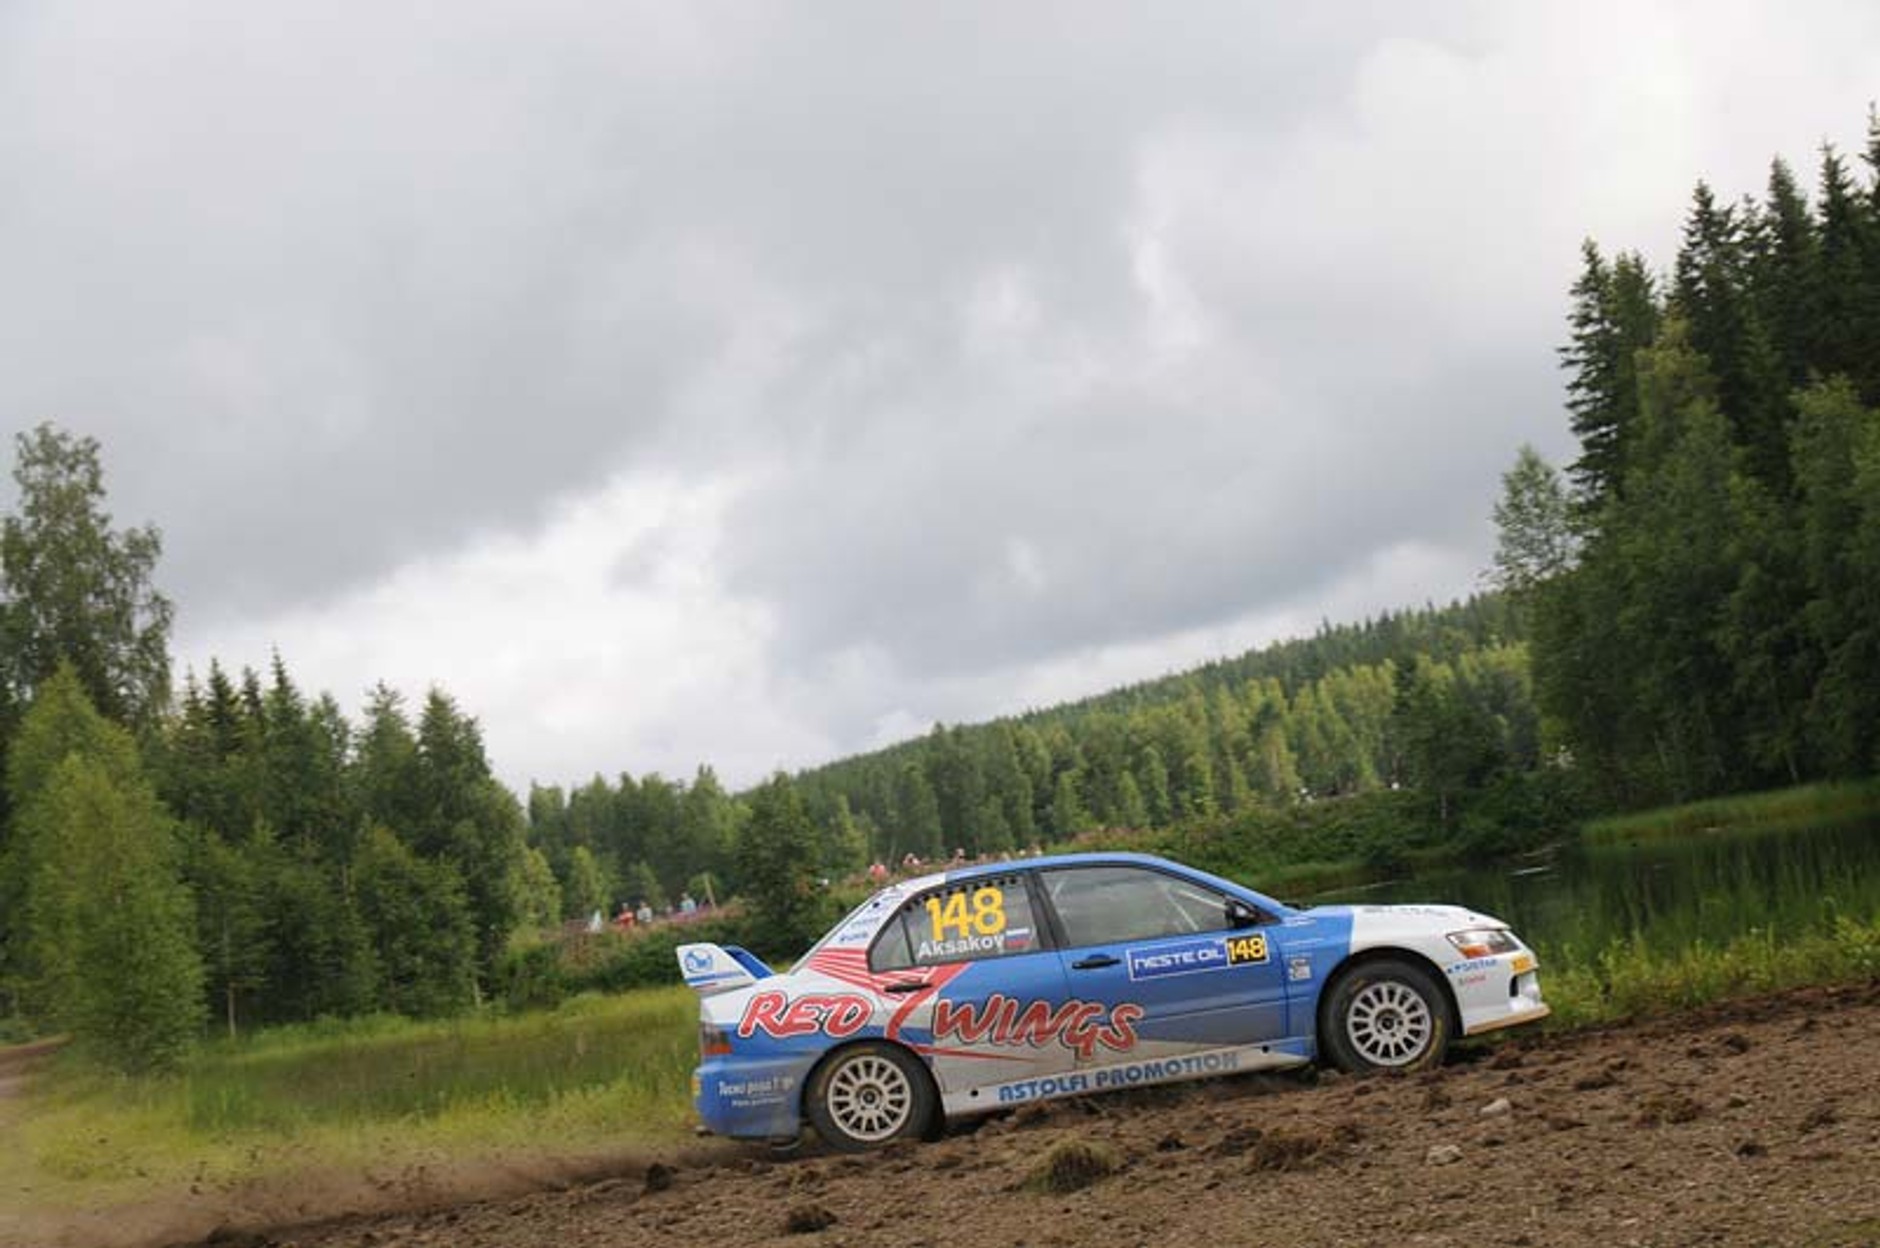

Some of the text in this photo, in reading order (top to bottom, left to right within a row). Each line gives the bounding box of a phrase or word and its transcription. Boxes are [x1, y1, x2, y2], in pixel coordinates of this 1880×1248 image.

[926, 887, 1006, 942] 148
[919, 935, 1004, 959] Aksakov
[1228, 937, 1264, 962] 148
[738, 990, 1144, 1060] RED WINGS
[1000, 1051, 1239, 1101] ASTOLFI PROMOTION
